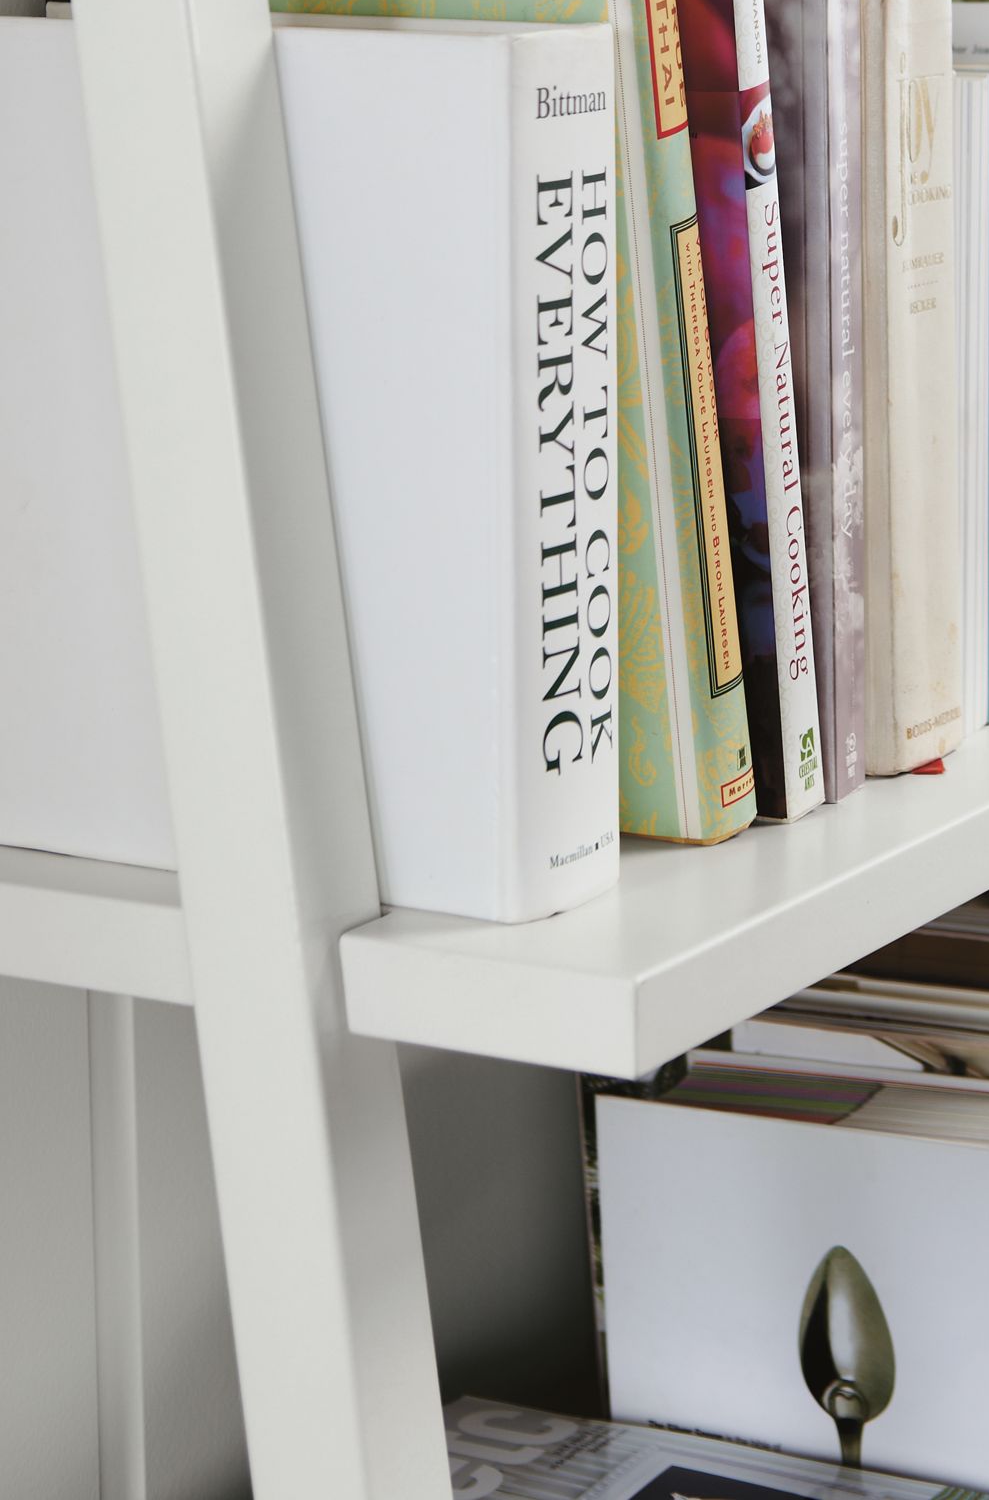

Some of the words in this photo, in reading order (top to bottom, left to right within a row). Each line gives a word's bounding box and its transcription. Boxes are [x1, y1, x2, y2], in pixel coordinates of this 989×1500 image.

[535, 84, 607, 120] Bittman
[836, 121, 849, 218] super
[580, 165, 610, 362] HOW
[685, 242, 694, 276] WITH
[761, 200, 784, 329] Super
[840, 232, 855, 357] natural
[697, 362, 708, 415] VOLPE
[773, 342, 799, 494] Natural
[838, 366, 855, 463] every
[534, 169, 585, 776] EVERYTHING
[582, 384, 611, 503] TO
[700, 421, 714, 498] LAURSEN
[709, 506, 717, 532] AND
[839, 478, 855, 539] day
[712, 535, 724, 591] BYRON
[784, 505, 810, 681] Cooking
[583, 527, 614, 766] COOK
[718, 597, 730, 671] LAURSEN
[799, 756, 818, 779] CELESTIAL
[804, 774, 815, 791] ARTS
[549, 842, 595, 871] Macmillan
[600, 830, 615, 855] USA
